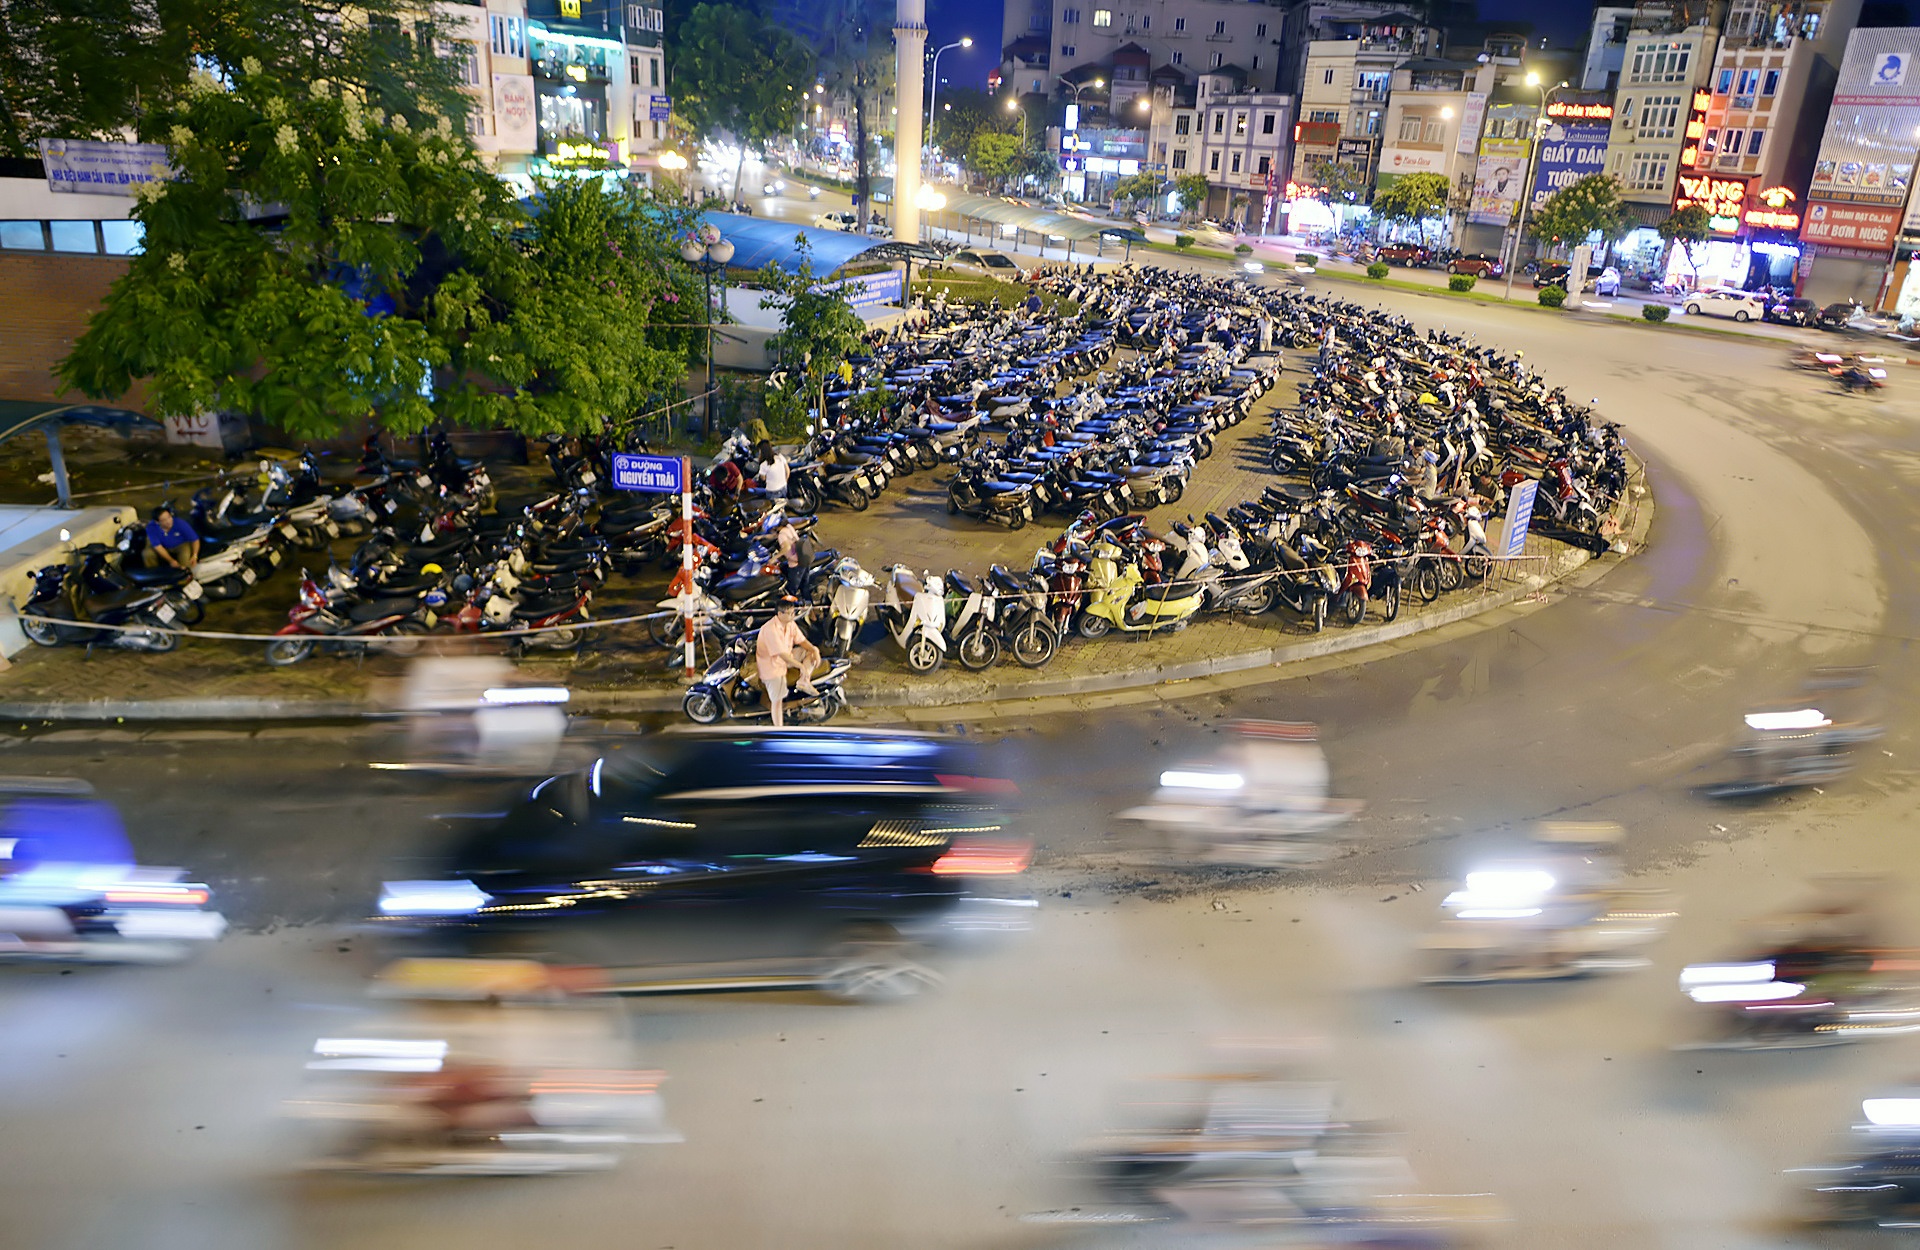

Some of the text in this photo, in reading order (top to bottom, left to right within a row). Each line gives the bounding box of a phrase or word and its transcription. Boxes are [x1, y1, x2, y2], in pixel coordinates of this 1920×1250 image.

[1548, 101, 1612, 119] GIẤY DÁN TƯỜNG
[1542, 142, 1575, 163] GIẤY
[1576, 145, 1607, 164] DÁN
[1680, 175, 1744, 202] VÀNG
[1832, 208, 1854, 220] THÀNH
[1807, 221, 1888, 242] MÁY BƠM NƯỚC
[620, 470, 675, 487] NGUYỄN TRÃI
